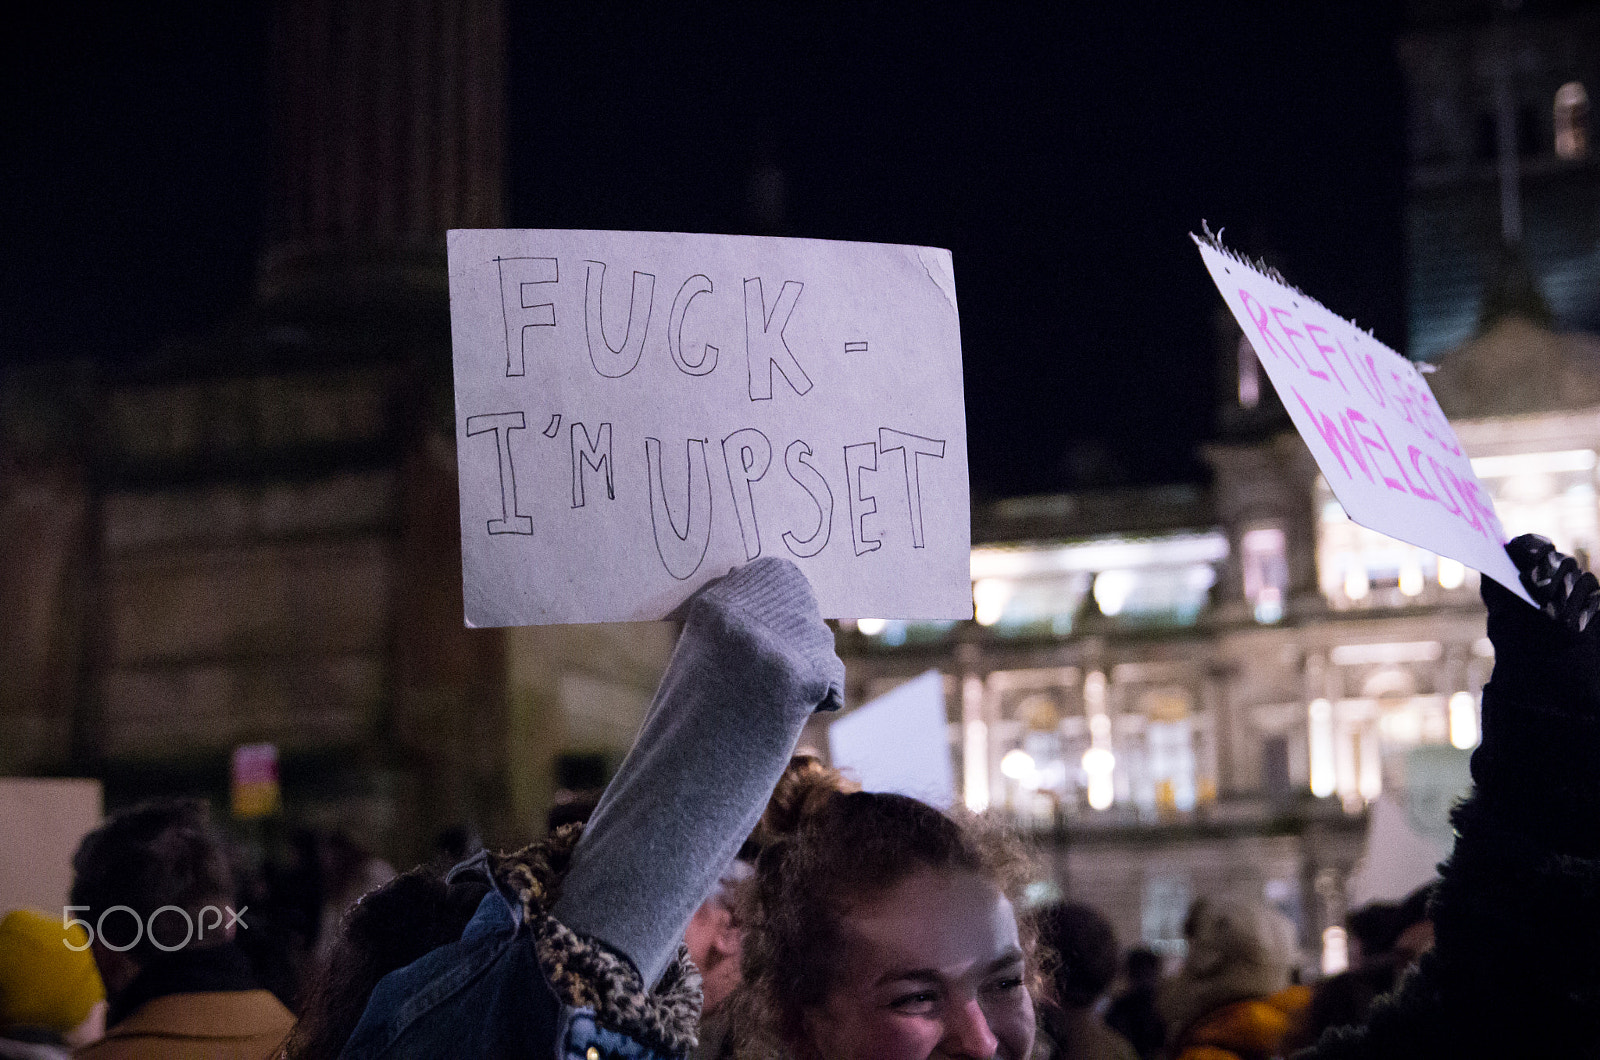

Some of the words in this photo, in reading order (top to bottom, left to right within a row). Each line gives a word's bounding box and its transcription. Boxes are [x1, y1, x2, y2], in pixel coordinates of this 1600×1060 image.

[492, 255, 813, 401] FUCK
[1238, 288, 1462, 457] REFUGEES
[466, 411, 615, 536] I'M
[645, 427, 946, 581] UPSET
